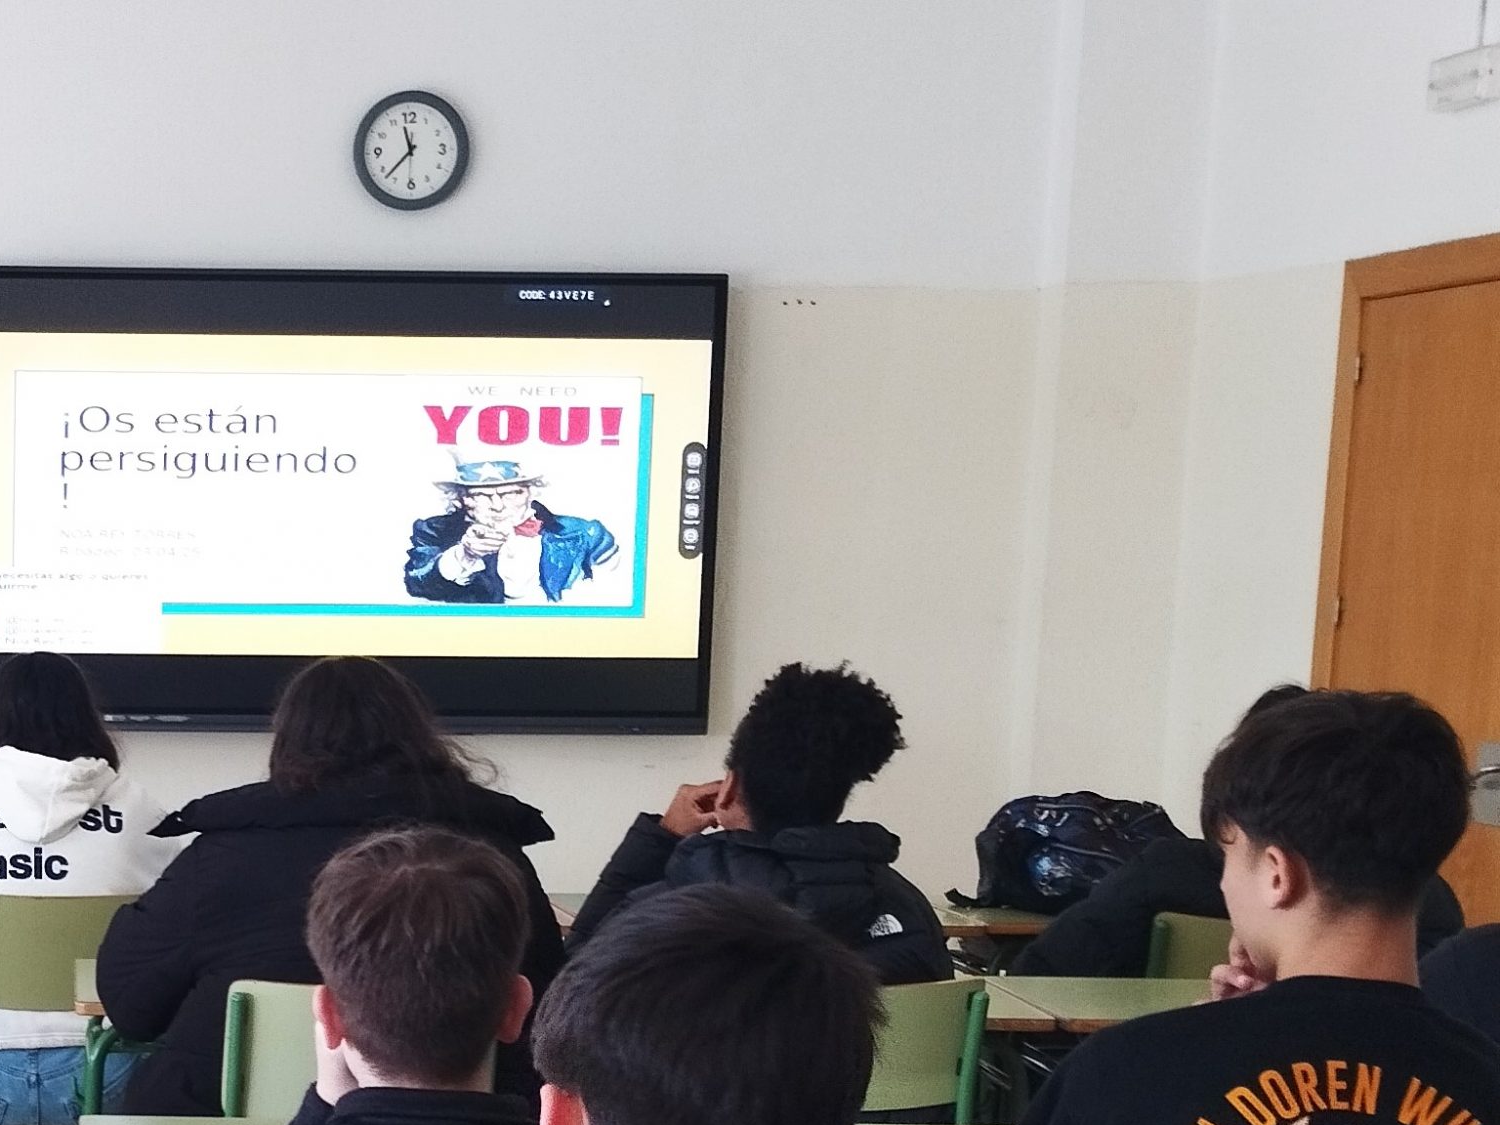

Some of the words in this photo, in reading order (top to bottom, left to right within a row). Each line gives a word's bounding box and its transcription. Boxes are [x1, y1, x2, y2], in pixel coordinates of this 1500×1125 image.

[402, 111, 417, 124] 12
[374, 147, 382, 159] 9
[438, 143, 447, 156] 3
[407, 178, 415, 189] 6
[467, 385, 501, 396] WE
[63, 404, 136, 439] ¡Os
[154, 404, 279, 435] están
[423, 404, 624, 447] YOU!
[60, 444, 358, 479] persiguiendo
